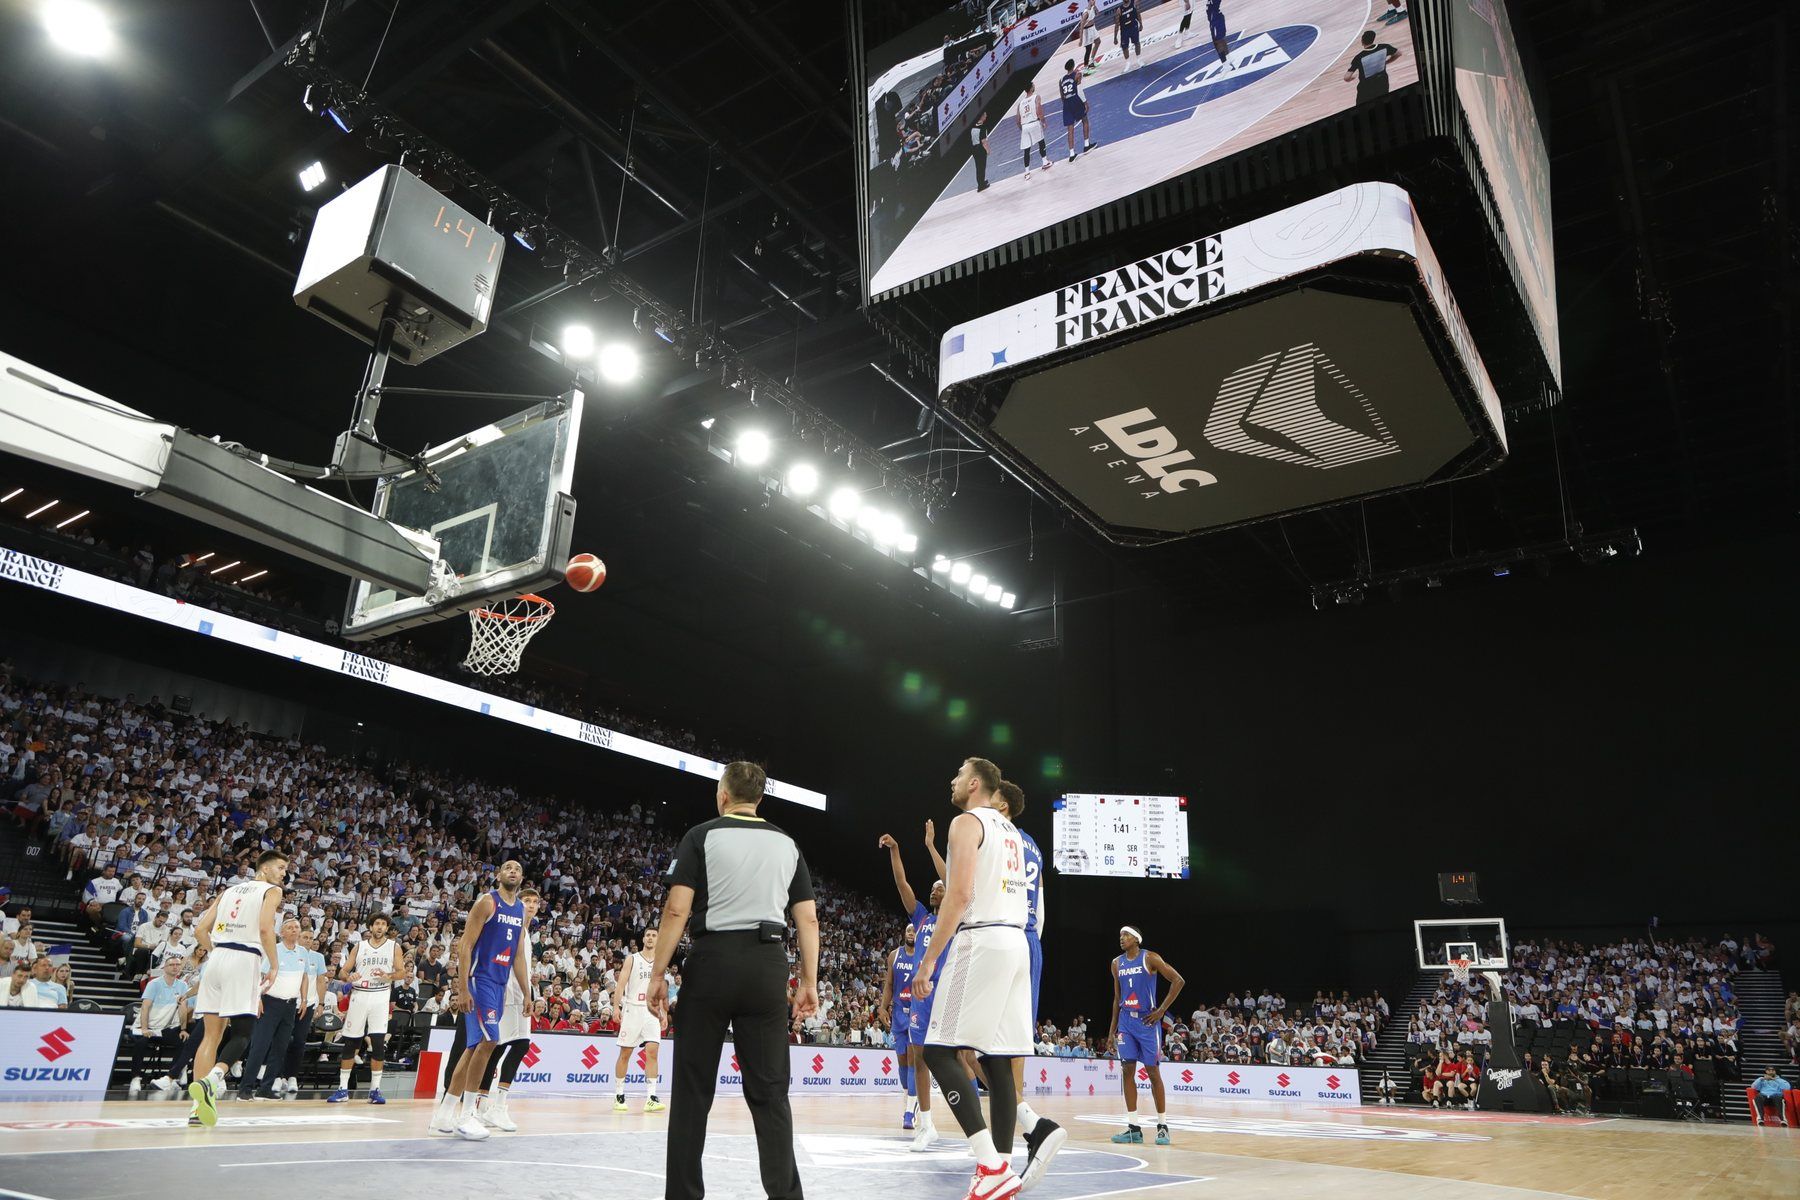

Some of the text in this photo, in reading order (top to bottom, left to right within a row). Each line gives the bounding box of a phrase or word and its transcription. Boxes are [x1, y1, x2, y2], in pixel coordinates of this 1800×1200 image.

[1021, 27, 1047, 42] SUZUKI
[1063, 84, 1073, 93] 32
[1055, 233, 1223, 318] FRANCE
[1055, 266, 1226, 349] FRANCE
[1093, 407, 1218, 493] LDLC
[1069, 426, 1160, 499] ARENA
[343, 651, 390, 673] FRANCE
[341, 661, 389, 683] FRANCE
[580, 722, 613, 739] FRANCE
[579, 731, 612, 747] FRANCE
[1113, 824, 1129, 833] 1:41
[26, 846, 41, 856] 007
[1104, 856, 1138, 866] 66 75
[1026, 861, 1039, 890] 2
[498, 913, 522, 927] FRANCE
[506, 928, 513, 940] 5
[923, 935, 931, 947] 9
[363, 957, 388, 966] SRBIJA
[897, 962, 913, 970] FRAN
[640, 971, 651, 979] SRB
[904, 972, 910, 982] 7
[1118, 966, 1142, 977] FRANCE
[1128, 978, 1133, 988] 1
[4, 1067, 91, 1081] SUZUKI
[513, 1072, 552, 1083] UZUKI
[566, 1072, 609, 1084] SUZUKI
[720, 1075, 743, 1085] SUZU
[803, 1077, 831, 1086] SUZUKI
[840, 1077, 867, 1086] SUZUKI
[874, 1077, 899, 1086] SUZUKI
[1268, 1089, 1301, 1097] SUZUKI
